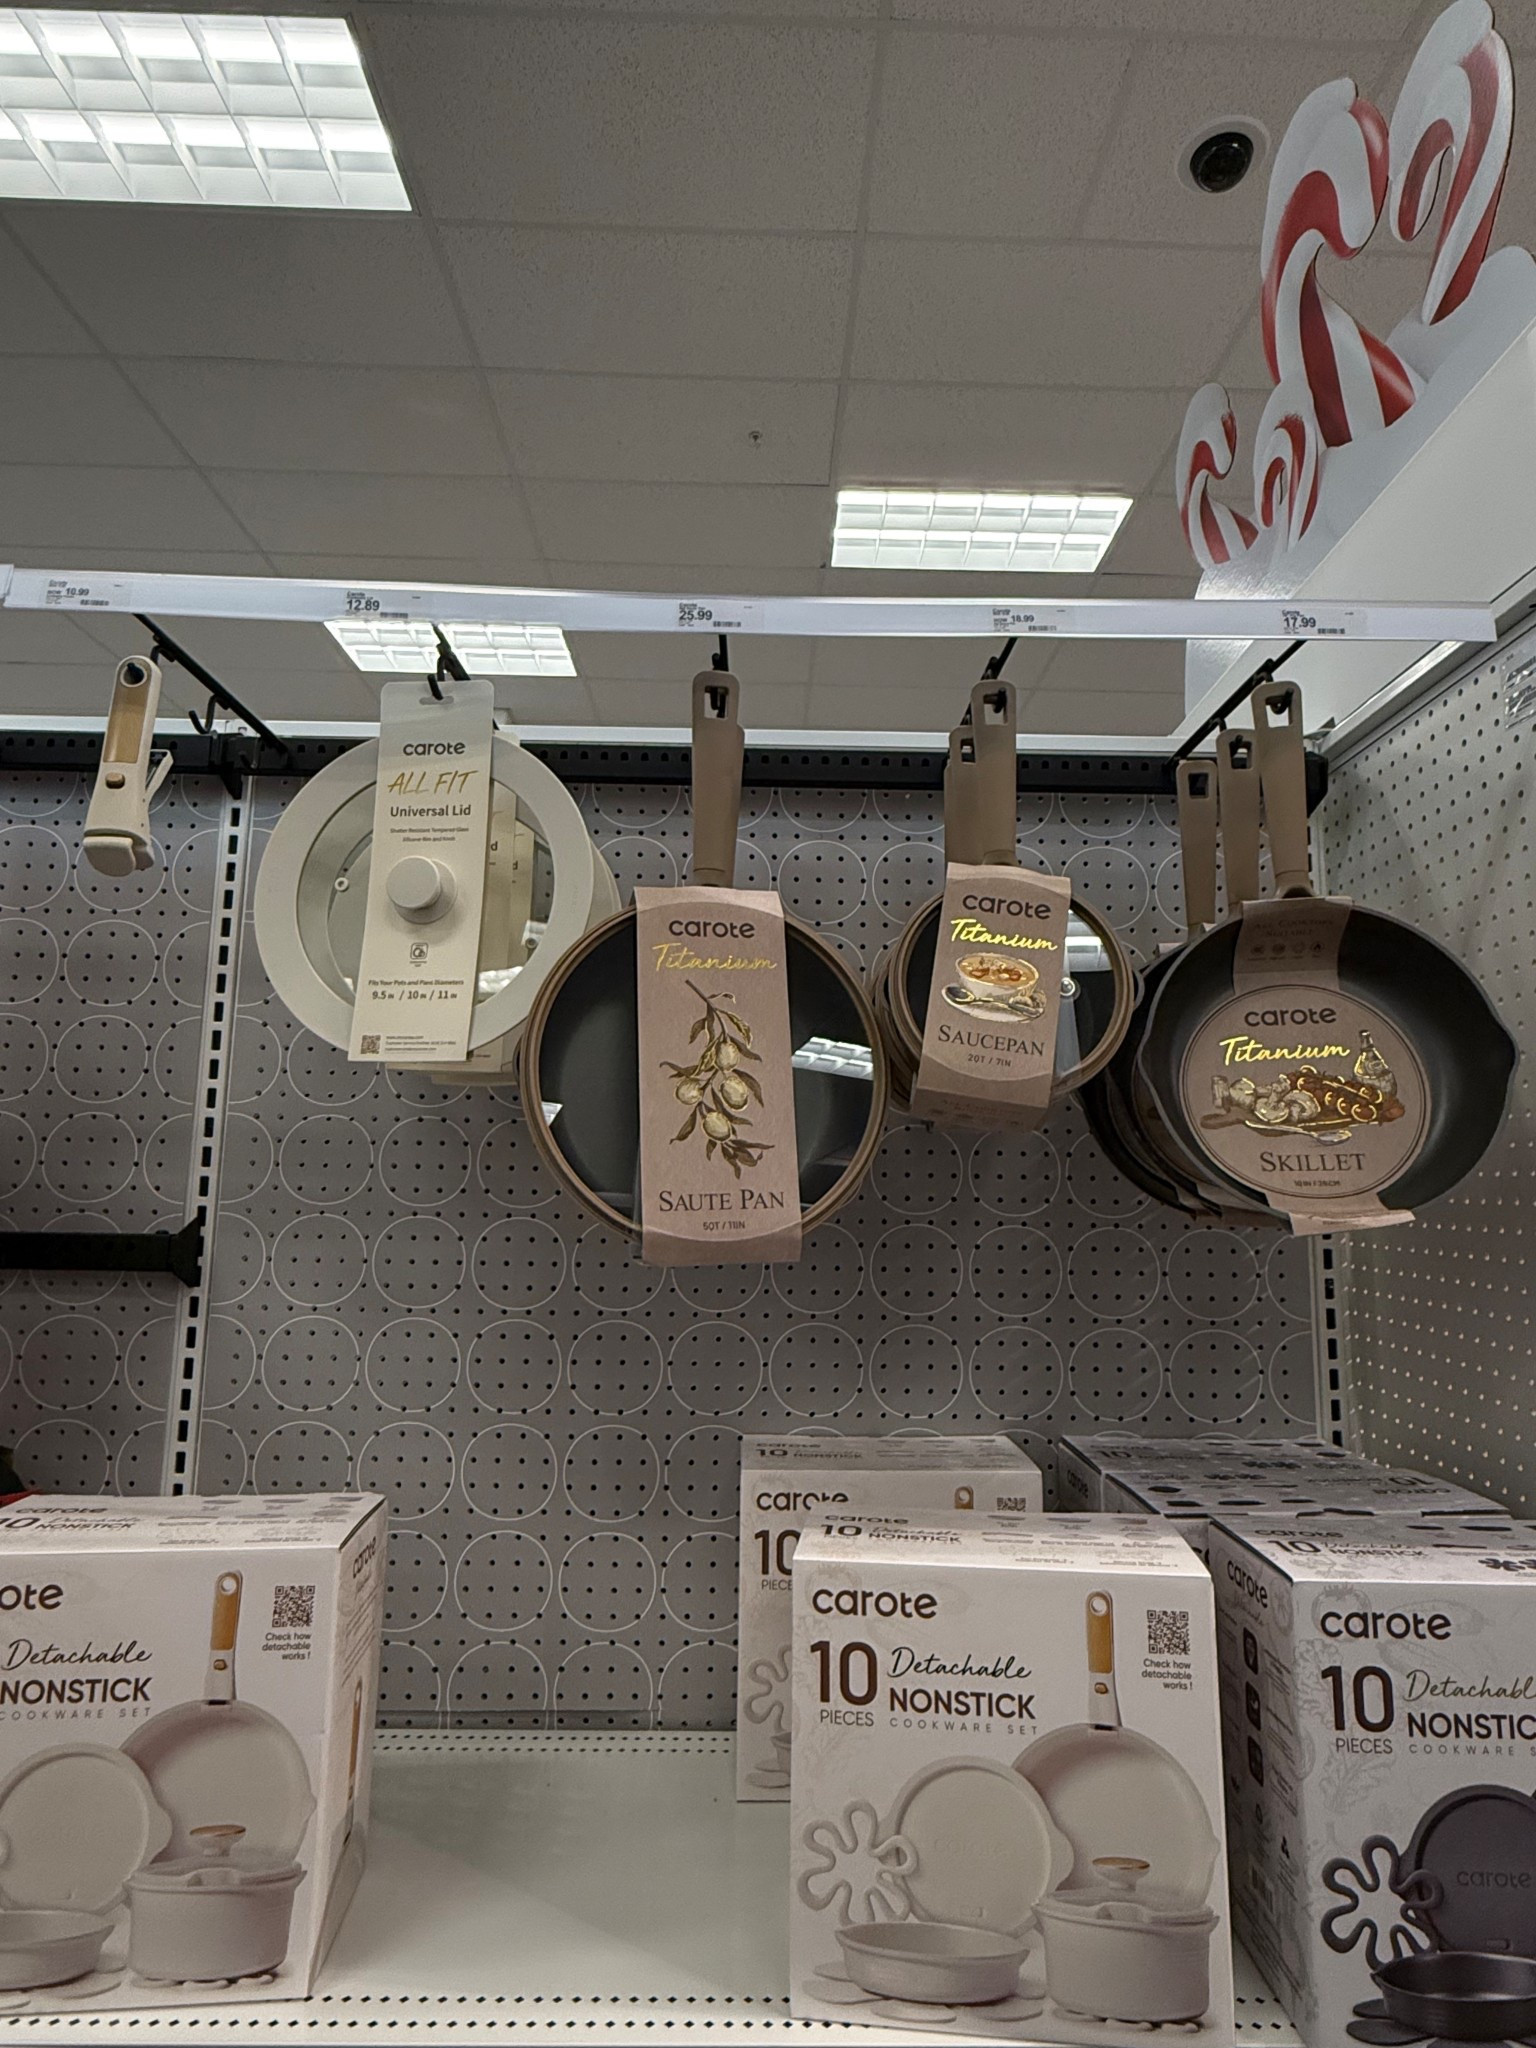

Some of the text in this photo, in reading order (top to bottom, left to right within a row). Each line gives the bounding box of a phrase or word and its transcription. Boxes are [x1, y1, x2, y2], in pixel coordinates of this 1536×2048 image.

[66, 587, 90, 596] 10.99
[346, 599, 380, 611] 12.89
[679, 610, 713, 621] 25.99
[1011, 615, 1035, 623] 18.99
[1283, 617, 1316, 628] 17.99
[403, 742, 466, 756] carote
[387, 770, 479, 795] ALL FIT
[390, 804, 471, 817] Universal Lid
[962, 894, 1052, 920] carote
[668, 920, 755, 939] carote
[951, 918, 1058, 951] Titanium
[651, 942, 778, 972] Titanium
[372, 990, 387, 1000] 9.5
[407, 990, 419, 999] 10
[438, 990, 449, 999] 11
[1244, 1007, 1338, 1027] carote
[938, 1025, 1046, 1057] SAUCEPAN
[968, 1054, 985, 1065] 2QT
[1219, 1036, 1351, 1066] Titanium
[1260, 1152, 1367, 1173] SKILLET
[659, 1189, 785, 1212] SAUTE PAN
[703, 1221, 720, 1232] 5QT
[756, 1449, 788, 1457] 10
[824, 1514, 909, 1524] carote
[821, 1524, 862, 1537] 10
[868, 1532, 961, 1543] NONSTICK
[1254, 1529, 1344, 1538] carote
[754, 1530, 801, 1576] 10
[1267, 1540, 1321, 1553] 10
[761, 1580, 793, 1591] PIECE
[1227, 1559, 1268, 1609] carote
[0, 1584, 64, 1610] ote
[812, 1589, 938, 1619] carote
[1320, 1611, 1452, 1641] carote
[265, 1632, 312, 1641] Check how
[1, 1638, 153, 1671] Detachable
[261, 1641, 311, 1651] detachable
[887, 1646, 1032, 1679] Detachable
[1143, 1658, 1191, 1670] Check how
[810, 1640, 878, 1707] 10
[1141, 1669, 1192, 1680] detachable
[0, 1677, 153, 1705] NONSTICK
[1402, 1669, 1536, 1702] Detachabl
[889, 1687, 1036, 1720] NONSTICK
[1321, 1665, 1395, 1733] 10
[119, 1707, 151, 1718] SET
[820, 1709, 875, 1727] PIECES
[890, 1717, 1038, 1736] COOKWARE SET
[1407, 1712, 1536, 1740] NONSTIC
[1335, 1737, 1393, 1754] PIECES
[1409, 1744, 1514, 1757] COOKWARE
[1456, 1869, 1531, 1889] carote
